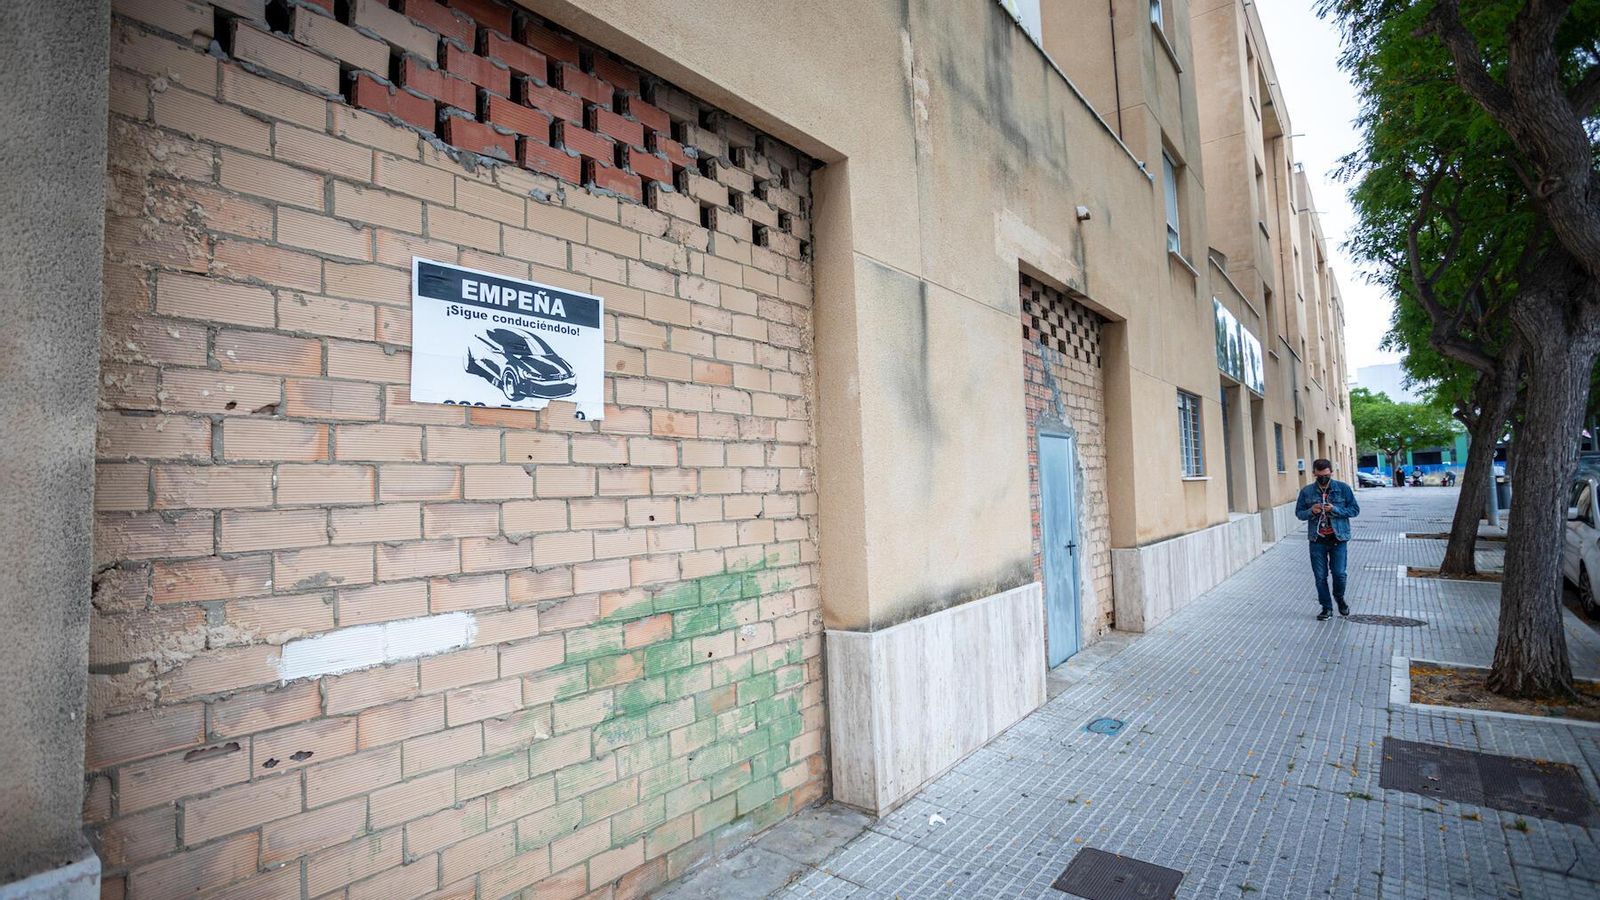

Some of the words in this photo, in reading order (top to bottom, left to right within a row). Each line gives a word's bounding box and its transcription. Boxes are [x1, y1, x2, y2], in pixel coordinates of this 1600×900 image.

[462, 279, 566, 317] EMPEÑA
[446, 304, 488, 320] ¡Sigue
[492, 313, 580, 336] conduciéndolo!
